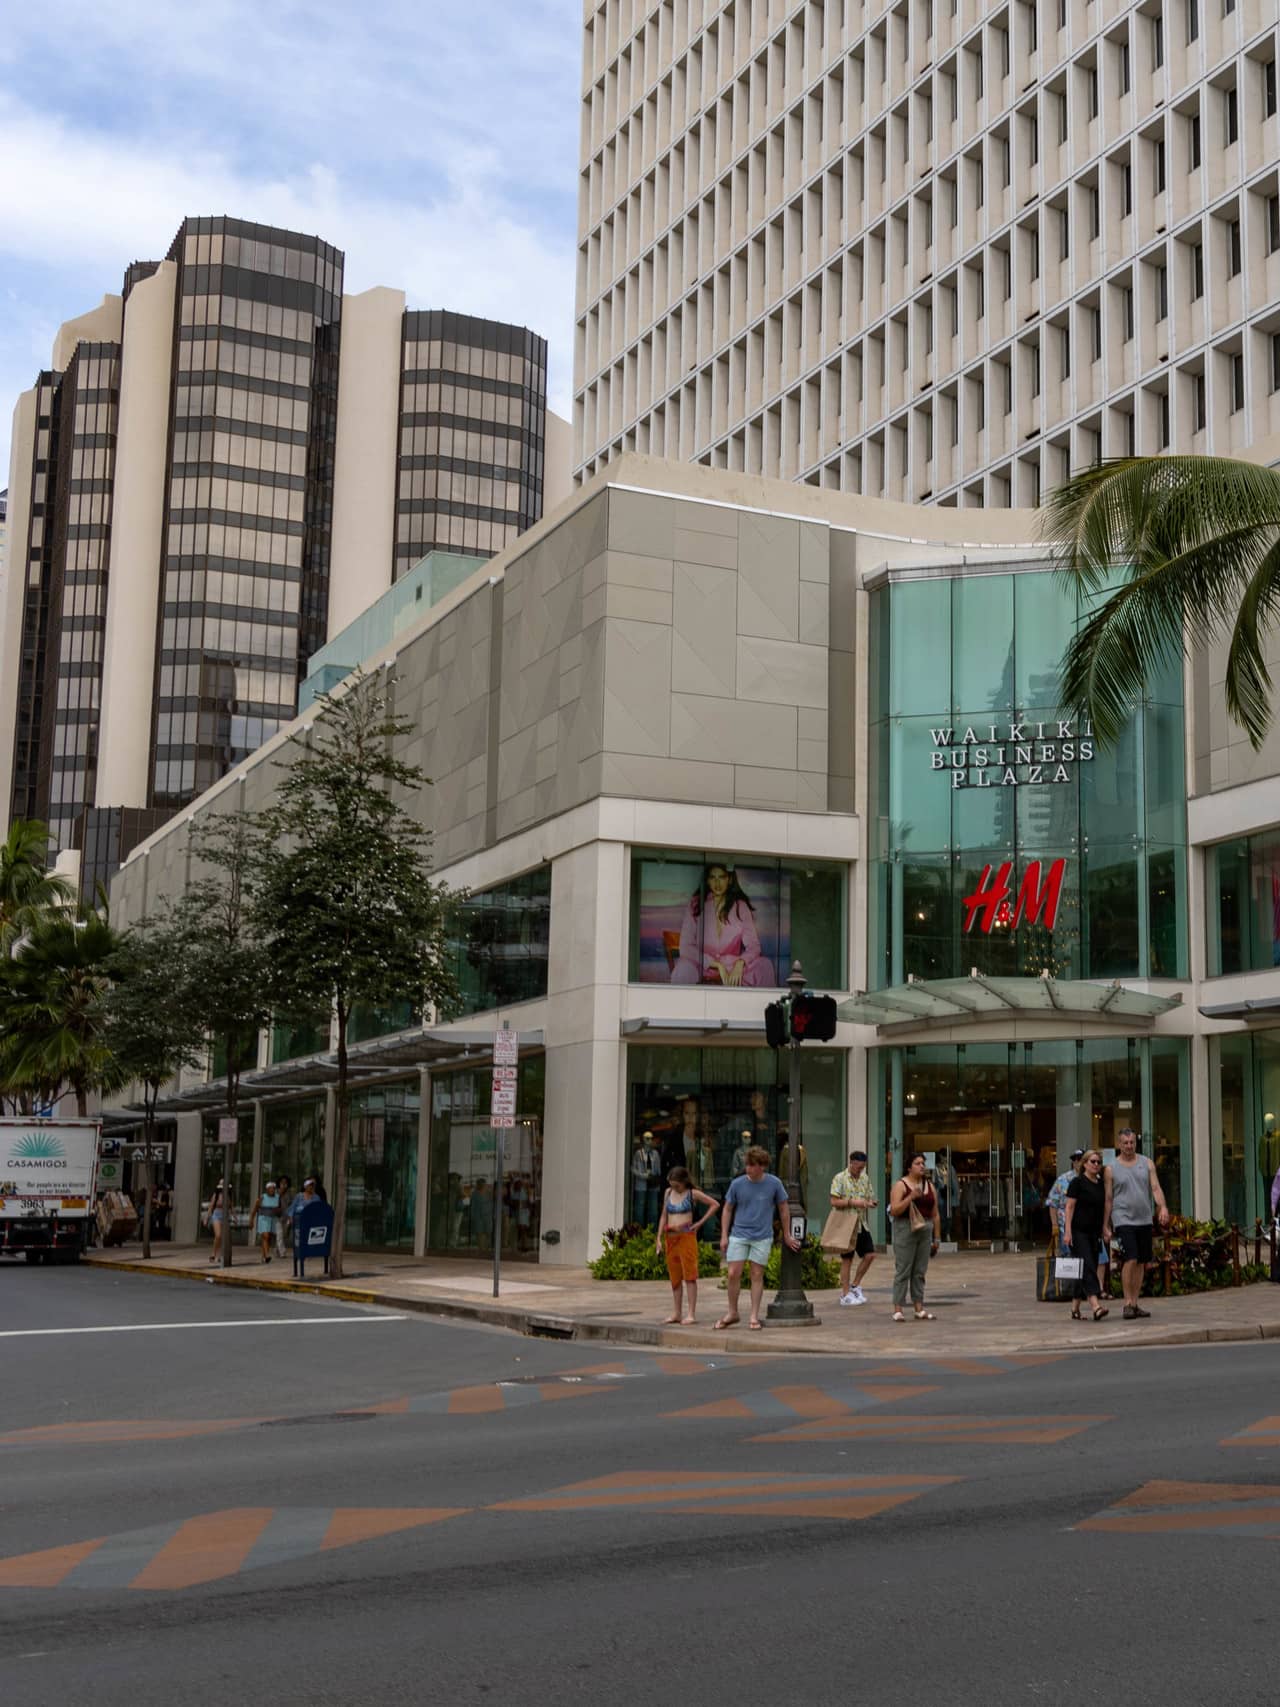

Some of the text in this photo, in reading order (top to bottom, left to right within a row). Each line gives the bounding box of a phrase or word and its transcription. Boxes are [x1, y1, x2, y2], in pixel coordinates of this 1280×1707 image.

[930, 720, 1094, 746] WAIKIKI
[930, 741, 1094, 769] BUSINESS
[951, 764, 1070, 789] PLAZA
[962, 858, 1067, 934] H&M
[7, 1159, 67, 1168] CASAMIGOS
[20, 1199, 45, 1209] 3963
